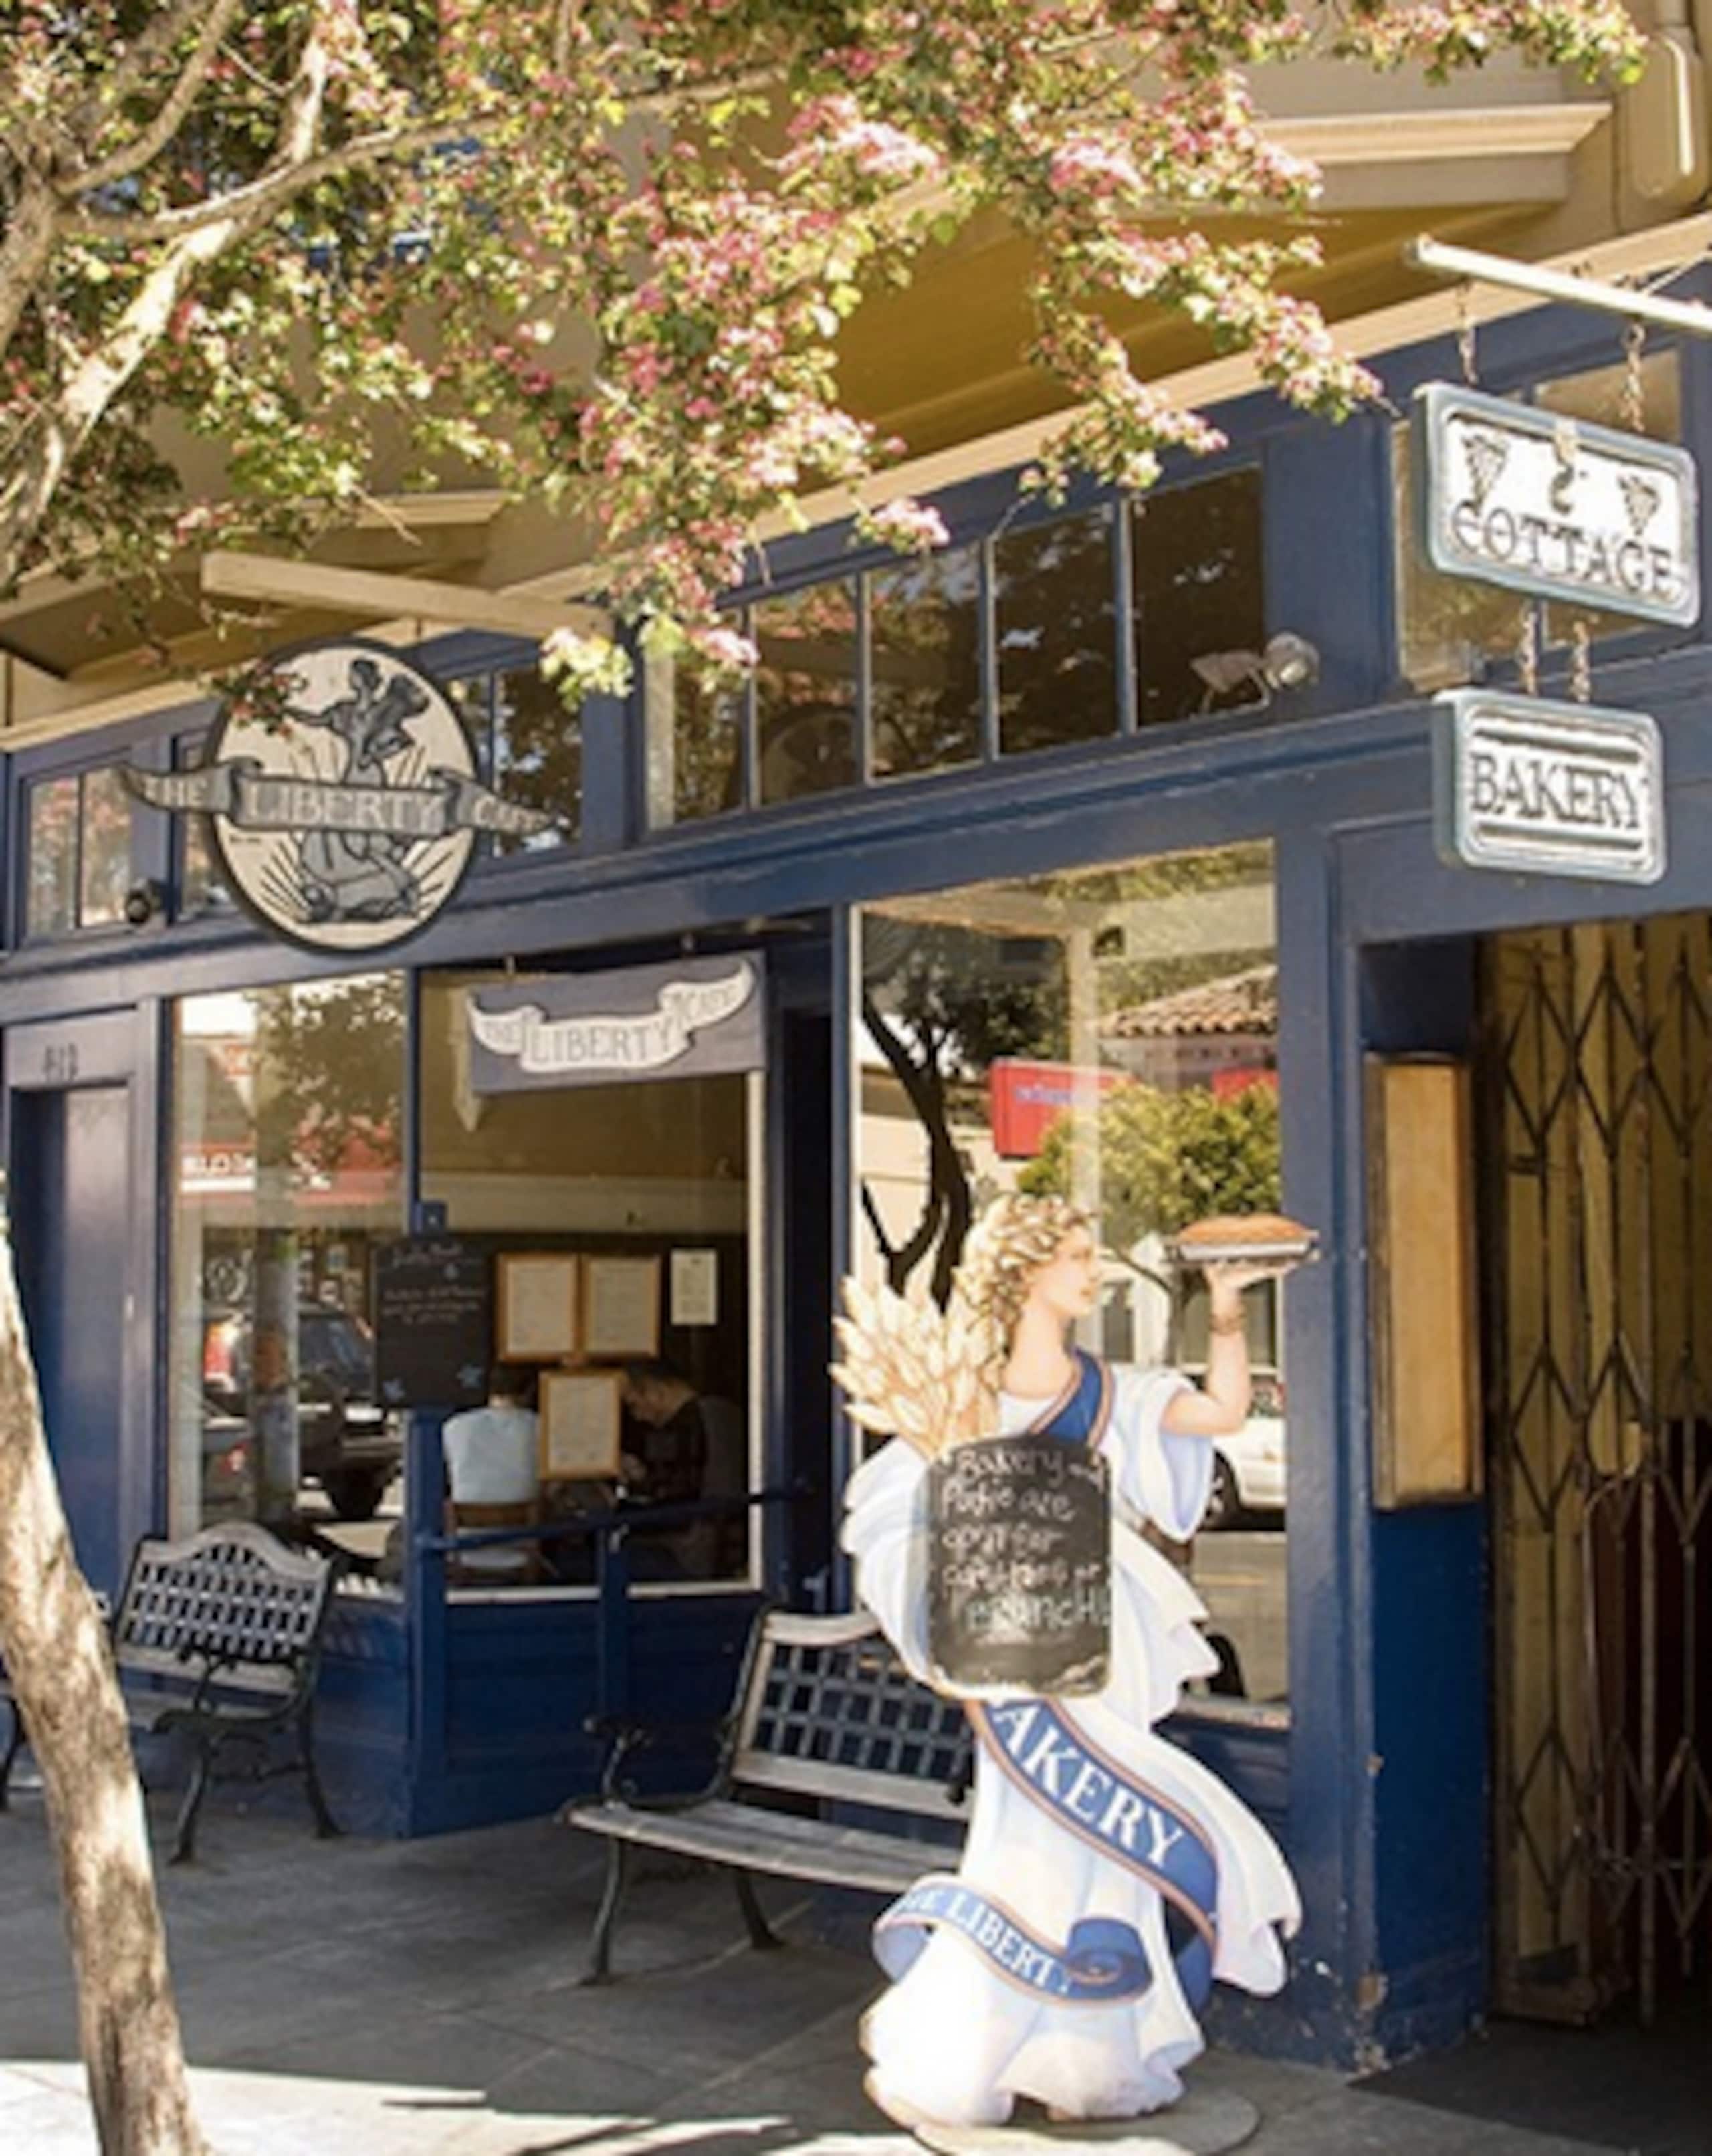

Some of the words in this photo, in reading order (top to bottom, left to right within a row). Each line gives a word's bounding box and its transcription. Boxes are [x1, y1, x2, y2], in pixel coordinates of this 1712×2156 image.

[1452, 500, 1671, 599] COTTAGE
[245, 783, 443, 829] LIBERTY
[1472, 752, 1650, 829] BAKERY
[530, 1020, 678, 1064] LIBERTY
[993, 1701, 1186, 1868] AKERY
